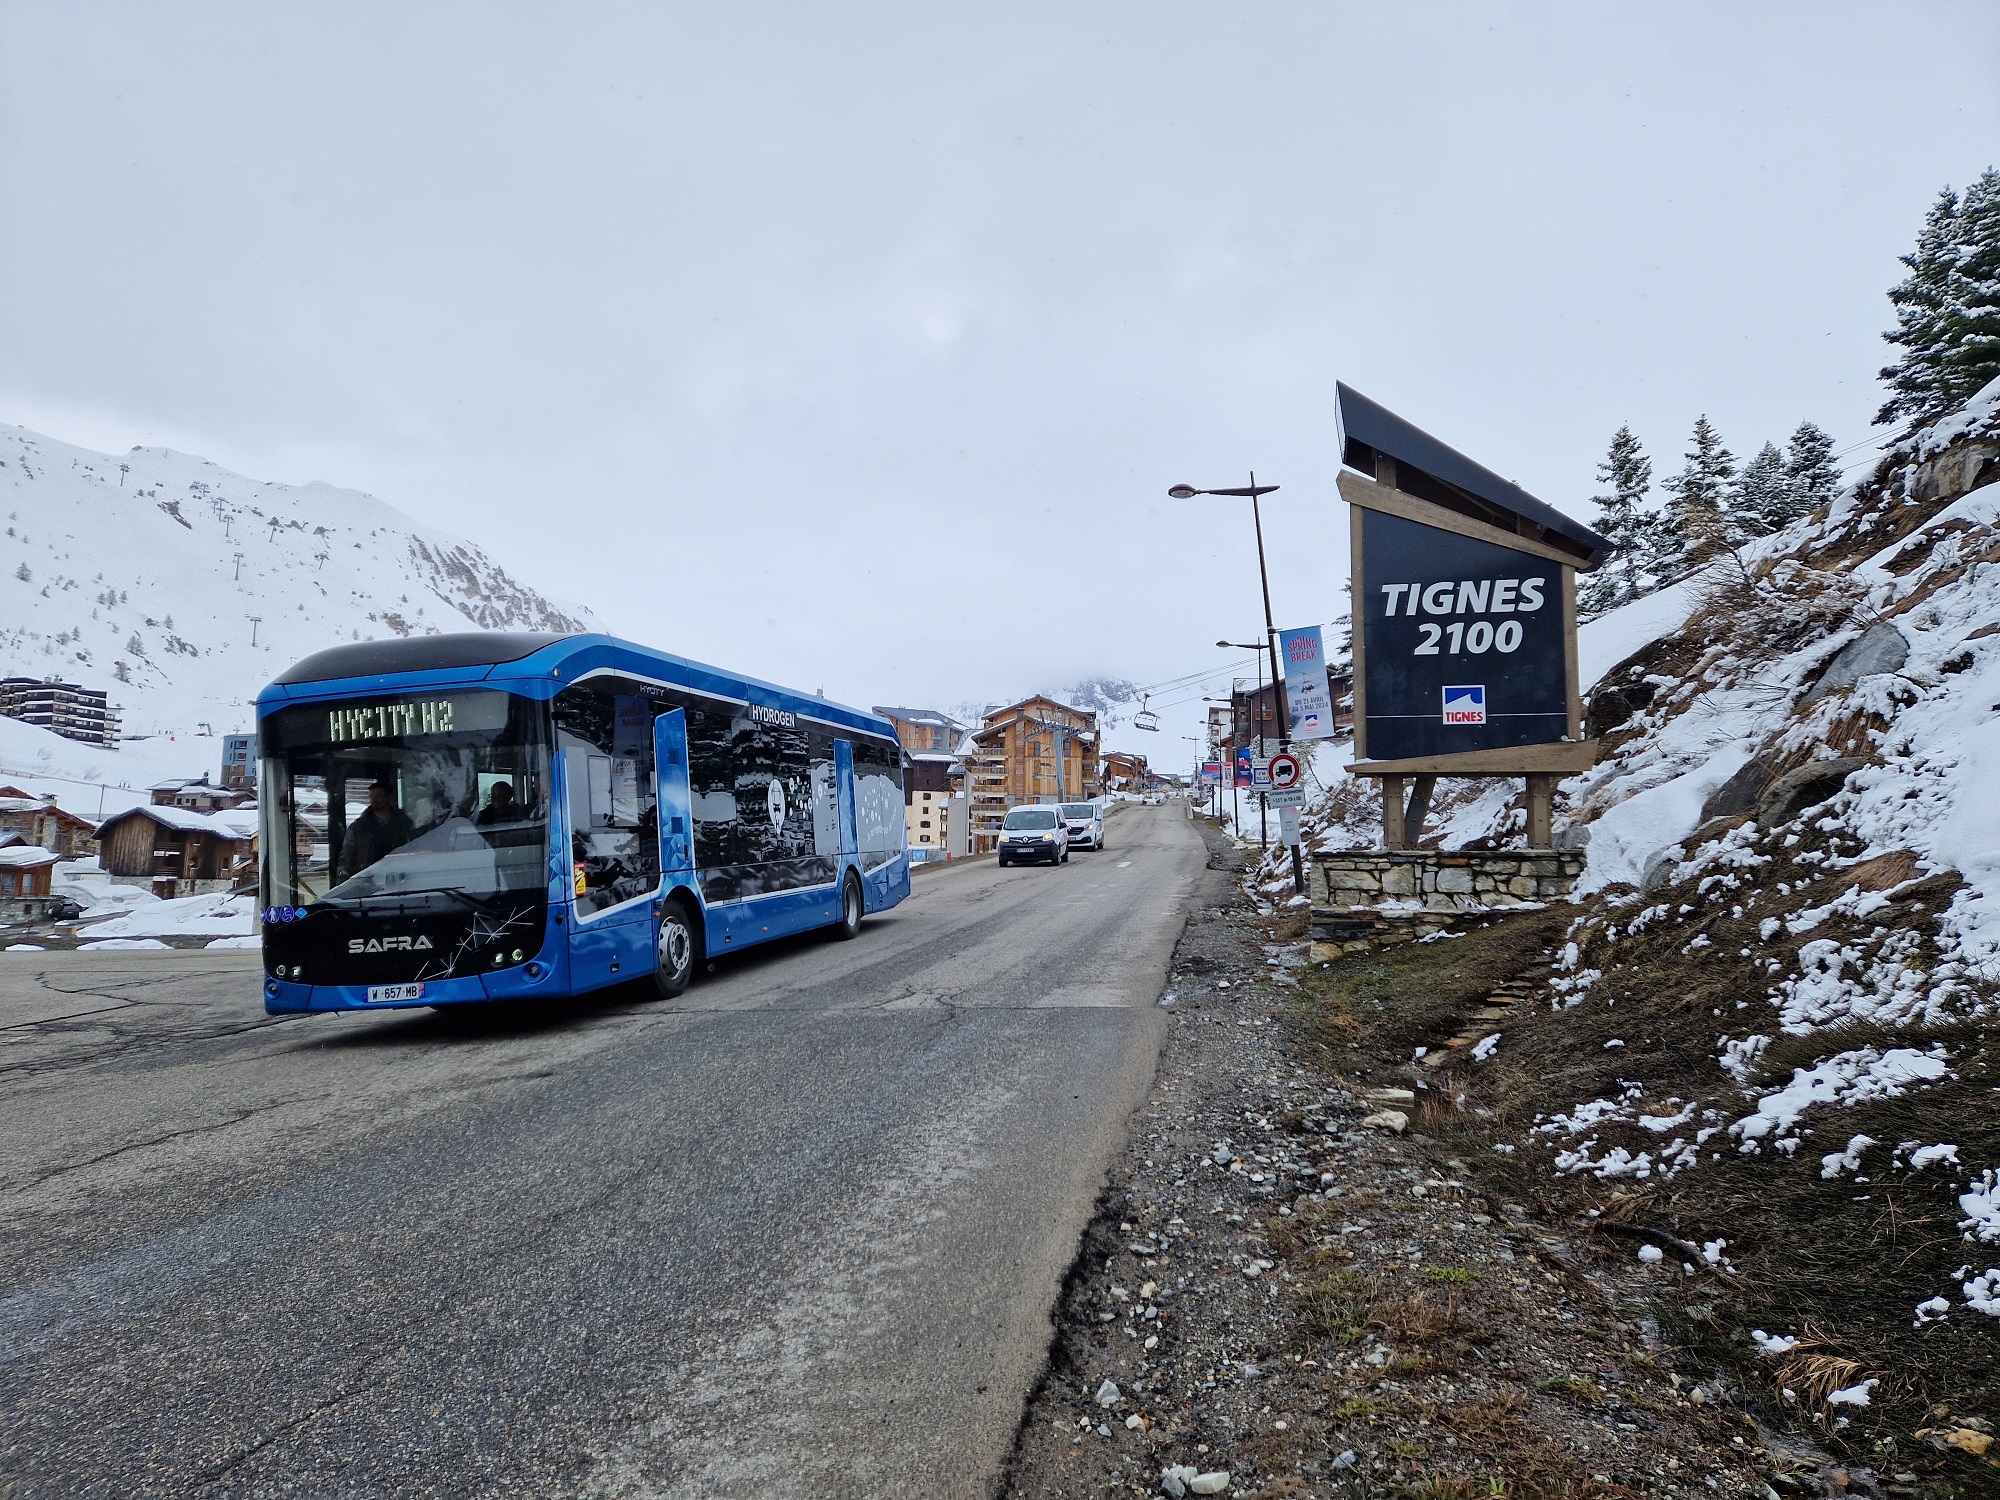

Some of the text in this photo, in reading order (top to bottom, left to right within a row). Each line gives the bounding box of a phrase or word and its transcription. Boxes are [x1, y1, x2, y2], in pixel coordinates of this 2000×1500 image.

[1381, 577, 1546, 616] TIGNES
[1287, 635, 1318, 652] SPRING
[1413, 620, 1524, 655] 2100
[1290, 650, 1316, 662] BREAK
[421, 700, 453, 733] H2
[752, 704, 795, 728] HYDROGEN
[1445, 711, 1484, 723] TIGNES
[348, 934, 433, 954] SAFRA
